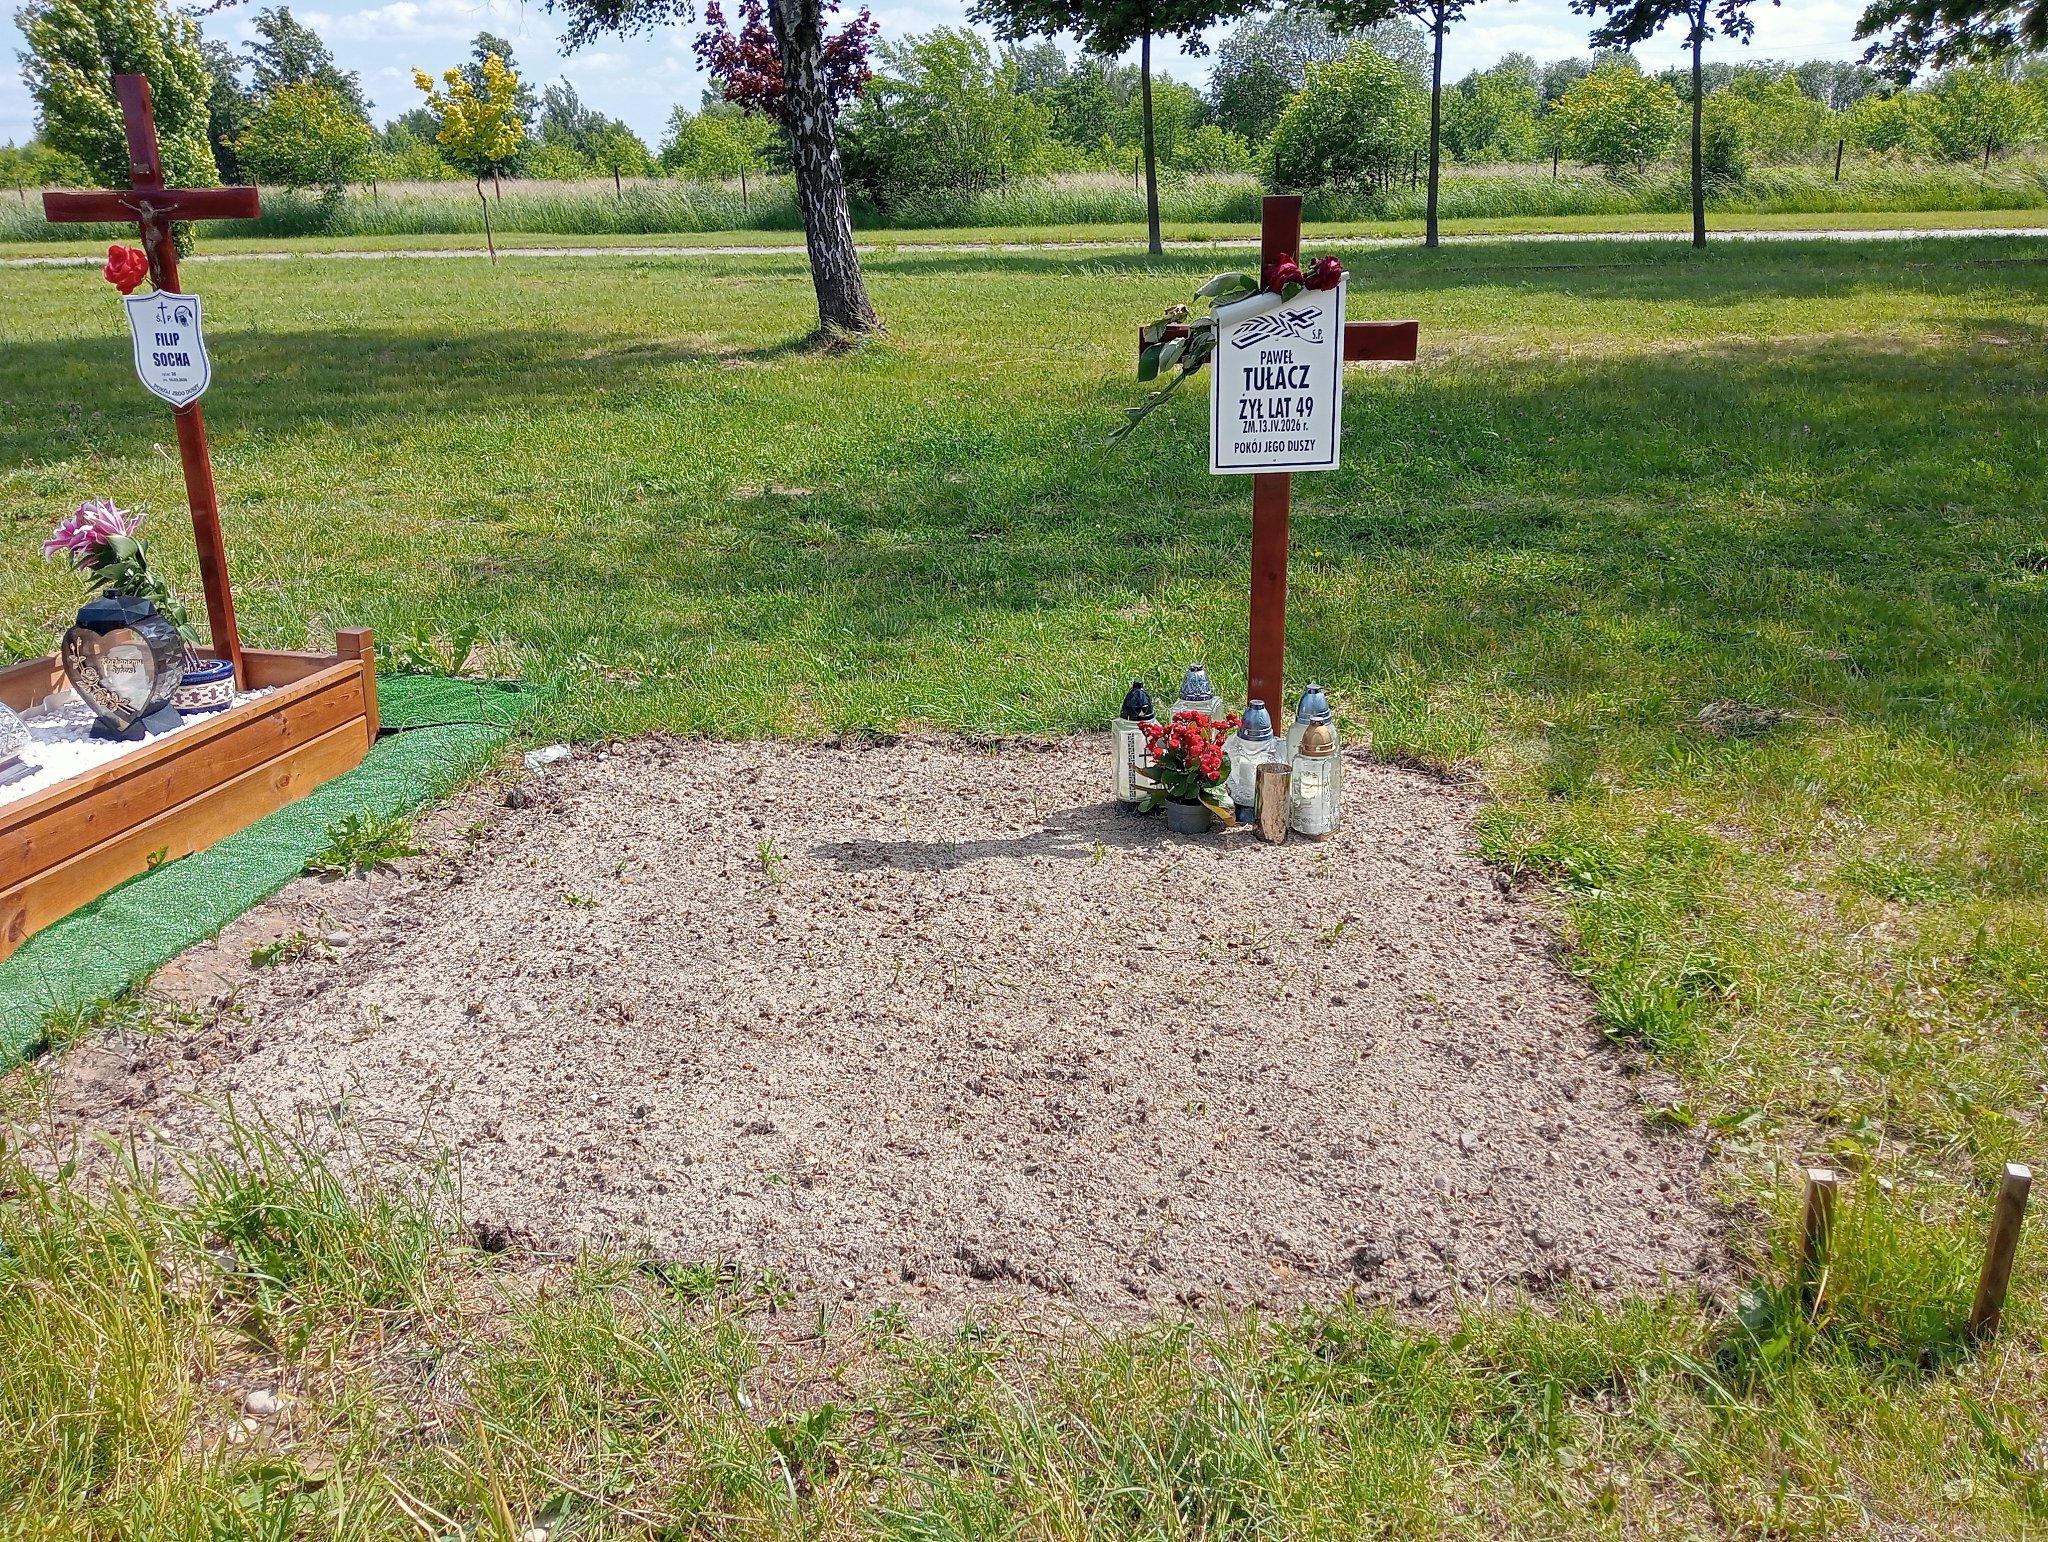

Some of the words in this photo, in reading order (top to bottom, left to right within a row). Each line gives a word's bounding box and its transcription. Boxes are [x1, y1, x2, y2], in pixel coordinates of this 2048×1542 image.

[155, 333, 180, 346] FILIP
[152, 352, 191, 367] SOCHA
[1260, 350, 1294, 365] PAWEŁ
[1243, 365, 1310, 391] TUŁACZ
[1239, 393, 1264, 420] ŻYŁ
[1268, 397, 1291, 418] LAT
[1296, 396, 1314, 418] 49
[1242, 418, 1301, 434] ZM.13.IV.2026
[1303, 421, 1309, 431] r.
[1234, 438, 1262, 454] POKÓJ
[1264, 440, 1285, 453] JEGO
[1287, 439, 1316, 452] DUSZY
